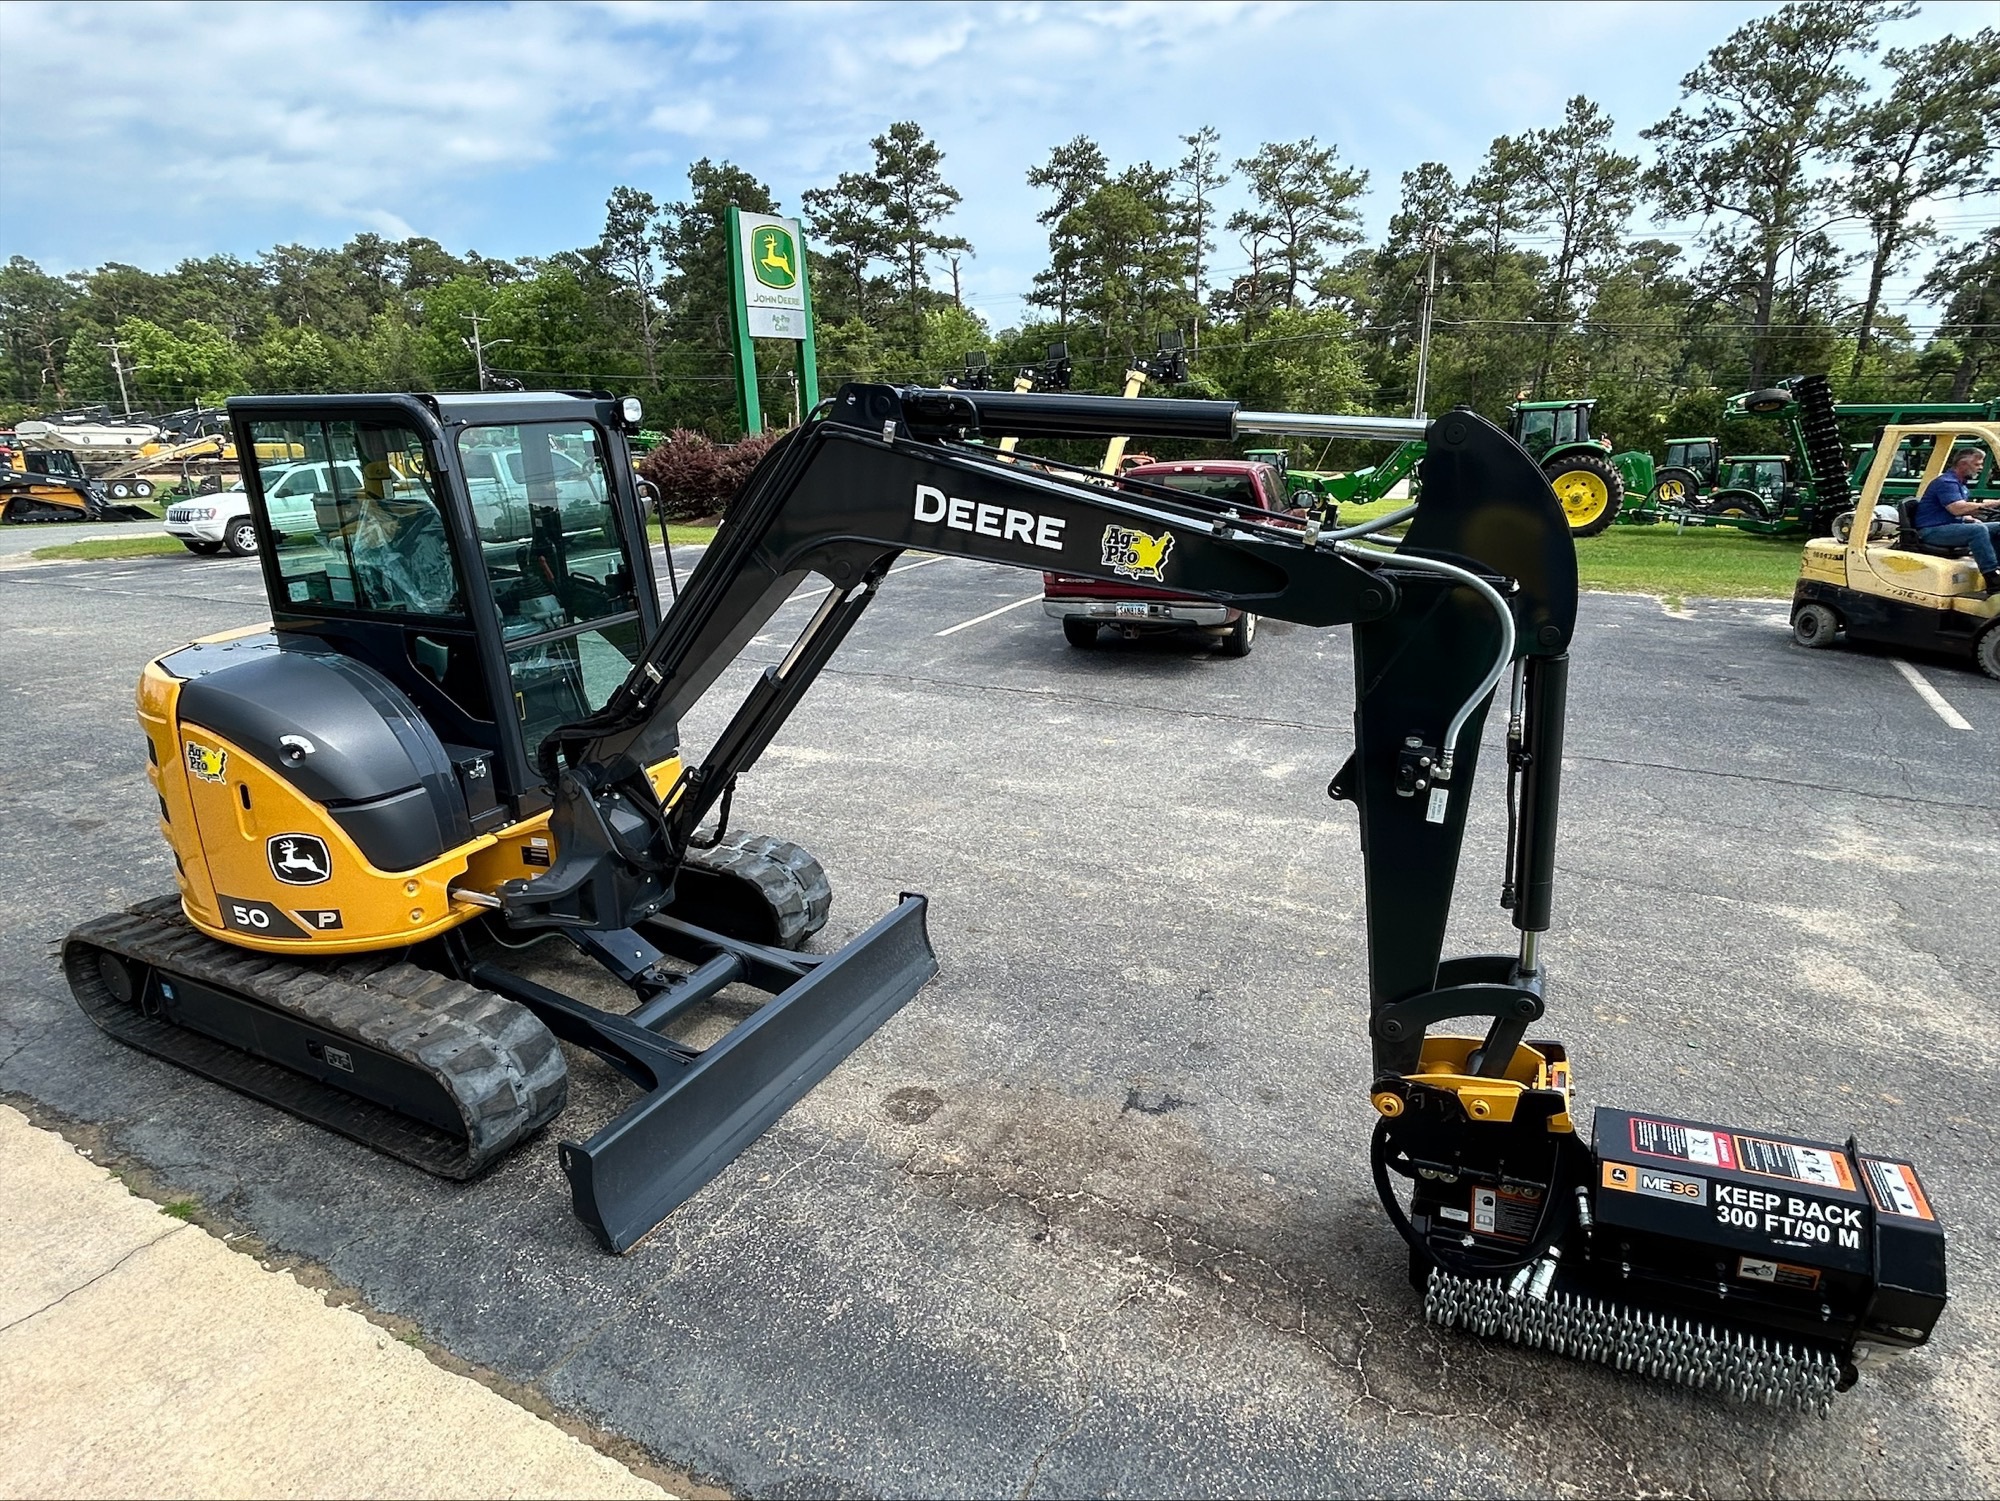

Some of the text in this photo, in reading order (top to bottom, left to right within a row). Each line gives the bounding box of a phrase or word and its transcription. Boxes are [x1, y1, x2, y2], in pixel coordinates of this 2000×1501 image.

[754, 293, 800, 305] JOHN DEERE
[914, 484, 1066, 551] DEERE
[1105, 528, 1139, 549] Ag-
[1105, 545, 1139, 564] Pro
[189, 757, 208, 771] Pro
[232, 905, 337, 928] 50 P
[1642, 1175, 1700, 1198] ME36
[1715, 1184, 1864, 1229] KEEP BACK
[1716, 1205, 1758, 1228] 300
[1764, 1213, 1830, 1243] FT/90
[1838, 1228, 1860, 1249] M
